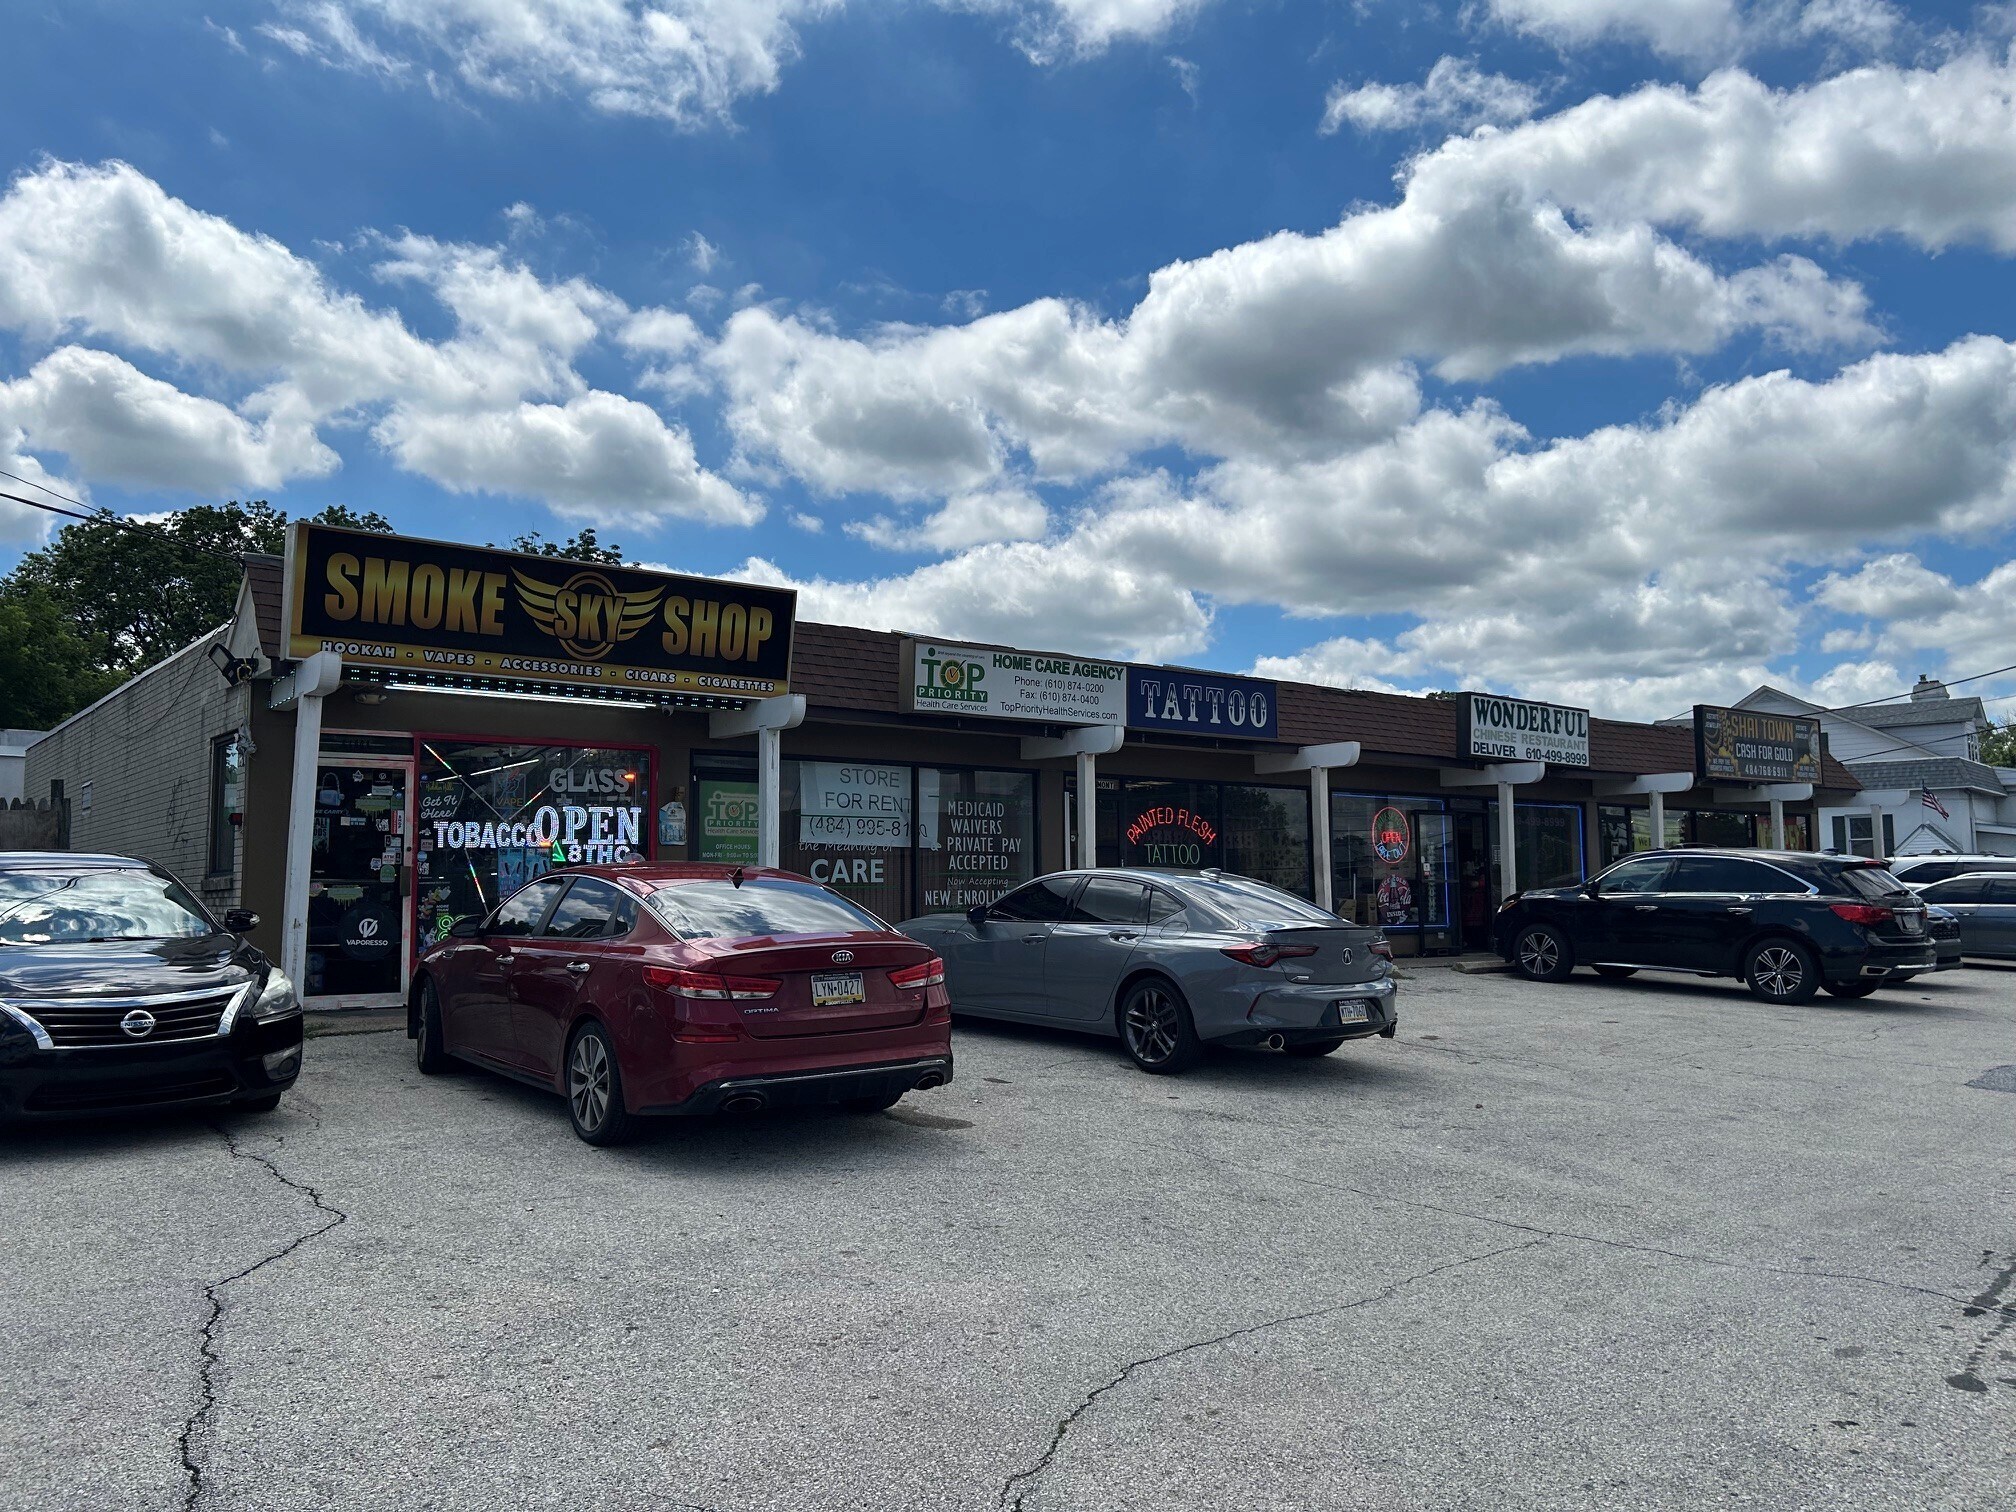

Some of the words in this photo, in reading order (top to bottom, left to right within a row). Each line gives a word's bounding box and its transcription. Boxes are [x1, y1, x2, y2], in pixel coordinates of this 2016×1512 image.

[324, 552, 507, 636] SMOKE
[554, 589, 626, 643] SKY
[662, 595, 773, 662] SHOP
[321, 641, 396, 658] HOOKAH
[424, 650, 475, 666] VAPES
[501, 657, 602, 677] ACCESSORIES
[625, 669, 676, 683] CIGARS
[698, 676, 775, 692] CIGARETTES
[921, 658, 986, 689] TOP
[992, 653, 1032, 671] HOME
[1035, 658, 1071, 676] CARE
[1072, 663, 1124, 681] AGENCY
[918, 686, 987, 701] PRIORITY
[1014, 675, 1043, 687] Phone:
[1045, 679, 1066, 691] (610)
[1067, 681, 1104, 693] 874-0200
[916, 699, 940, 708] Health
[942, 701, 958, 710] Care
[960, 702, 987, 712] Services
[1020, 689, 1037, 699] Fax:
[1039, 690, 1060, 703] (610)
[1062, 693, 1099, 705] 874-0400
[1141, 680, 1267, 728] TATTOO
[1000, 702, 1118, 720] TopPriorityHealthServices.com
[1474, 698, 1587, 738] WONDERFUL
[1731, 715, 1759, 739] SHAI
[1762, 719, 1794, 743] TOWN
[1473, 728, 1517, 743] CHINESE
[1521, 733, 1587, 751] RESTAURANT
[1473, 741, 1517, 758] DELIVER
[1525, 747, 1587, 765] 610-499-8999
[1736, 743, 1756, 759] CASH
[1758, 745, 1773, 761] FOR
[1774, 747, 1793, 762] GOLD
[550, 767, 630, 793] GLASS
[840, 768, 900, 788] STORE
[422, 795, 442, 807] Get
[709, 801, 758, 820] TOP
[825, 792, 863, 810] FOR
[868, 794, 910, 813] RENT
[948, 801, 1005, 818] MEDICAID
[420, 807, 458, 819] Here!
[534, 806, 641, 845] OPEN
[709, 819, 758, 828] PRIORITY
[809, 817, 851, 838] (484)
[951, 818, 1002, 835] WAIVERS
[1126, 807, 1174, 846] PAINTED
[1177, 808, 1217, 846] FLESH
[434, 820, 541, 848] TOBACCO
[947, 837, 993, 853] PRIVATE
[1002, 838, 1022, 853] PAY
[1144, 843, 1201, 865] TATTOO
[810, 858, 885, 884] CARE
[949, 855, 1008, 870] ACCEPTED
[947, 877, 965, 886] Now
[969, 877, 1009, 888] Accepting
[925, 890, 950, 906] NEW
[958, 890, 1010, 906] ENROLLM
[346, 939, 389, 947] VAPORESSO
[836, 953, 851, 961] KIA
[744, 1006, 780, 1014] OPTIMA
